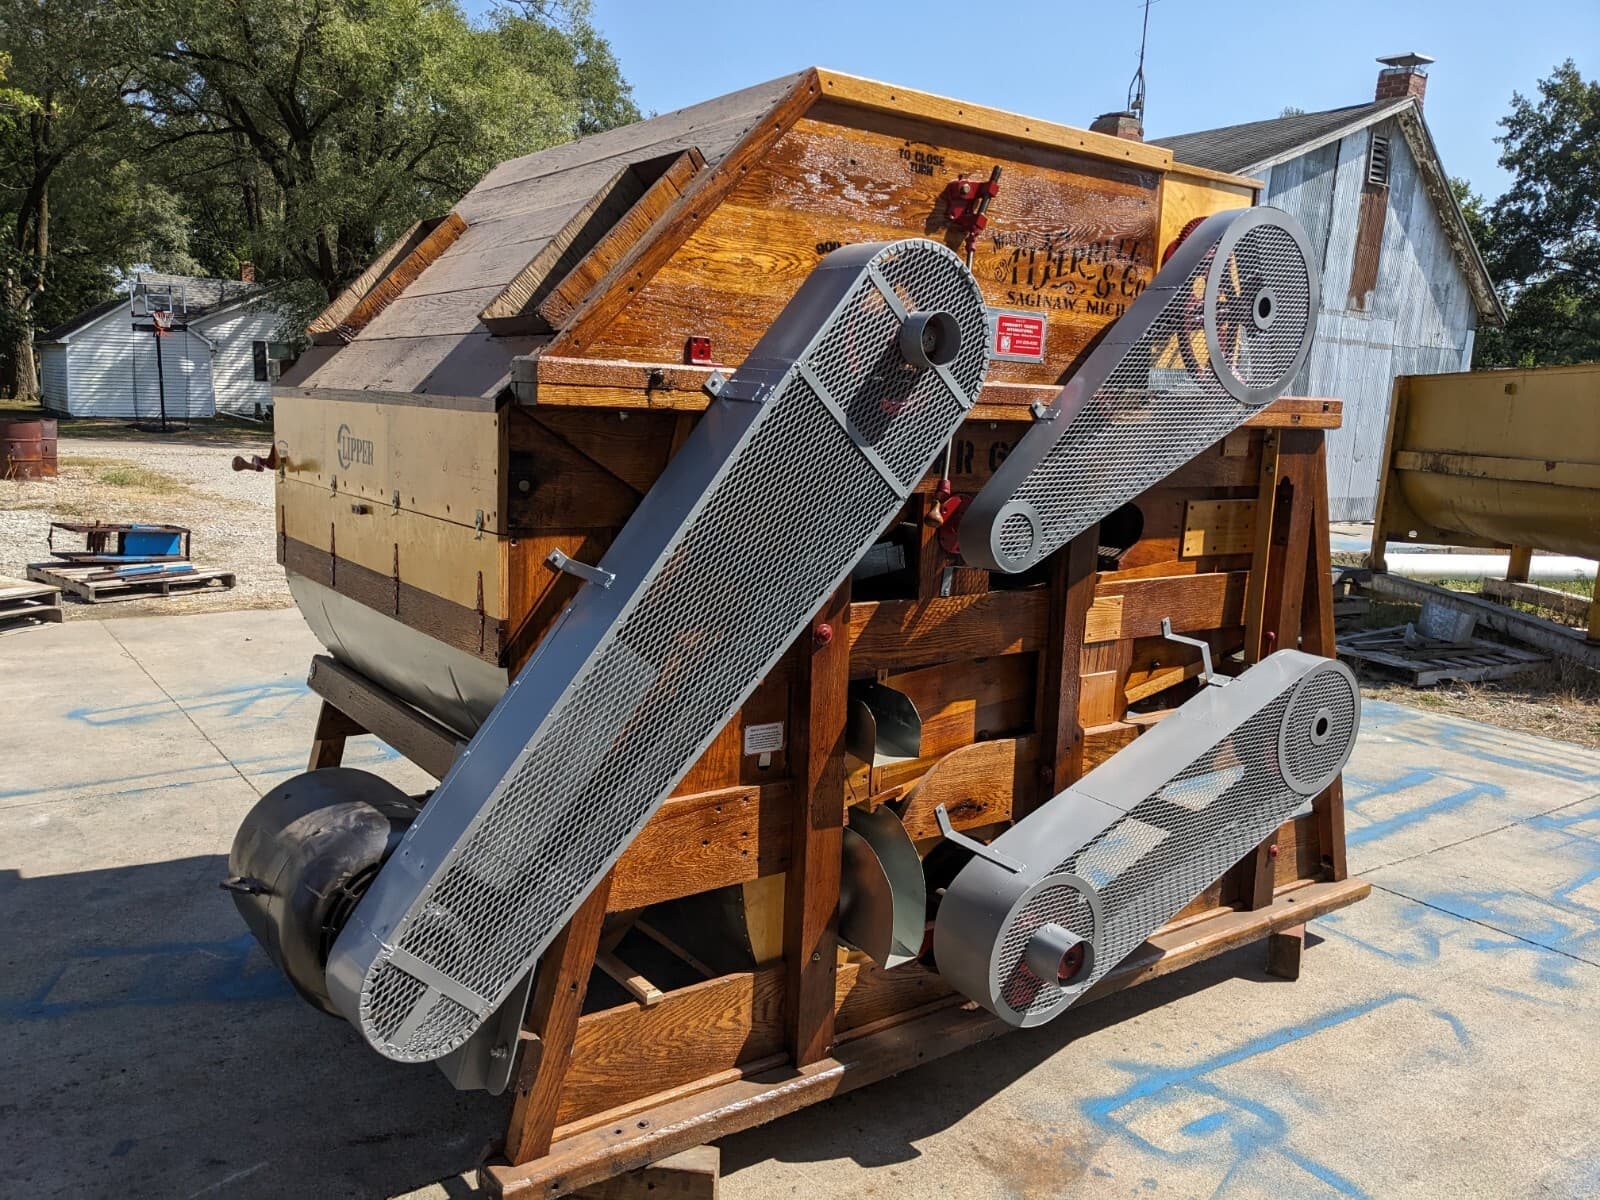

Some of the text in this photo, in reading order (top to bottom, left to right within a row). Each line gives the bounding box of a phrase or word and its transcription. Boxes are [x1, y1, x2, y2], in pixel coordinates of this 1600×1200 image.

[898, 148, 945, 167] TO CLOSE
[910, 161, 933, 177] TURN
[337, 423, 375, 471] CLIPPER
